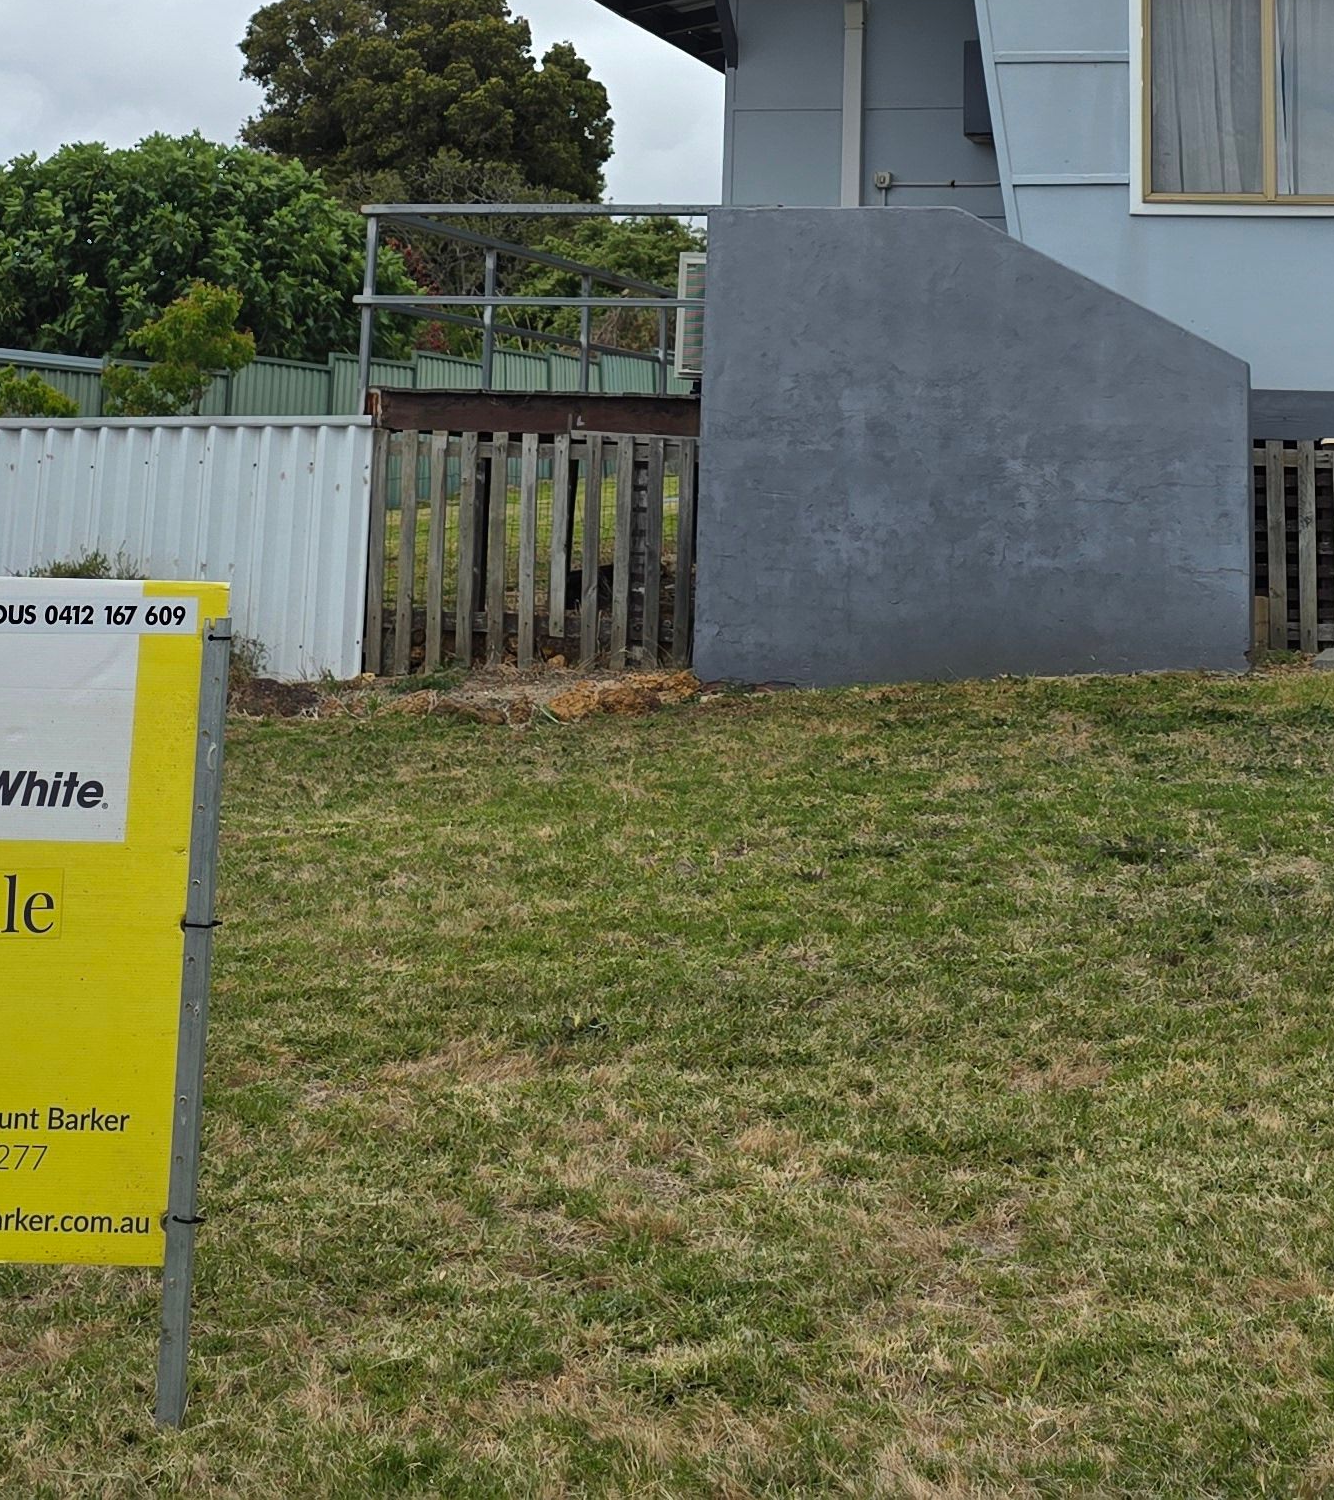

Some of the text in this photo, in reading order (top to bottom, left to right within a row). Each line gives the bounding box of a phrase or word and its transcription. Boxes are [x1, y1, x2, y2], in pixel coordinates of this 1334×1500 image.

[44, 604, 95, 626] 0412
[103, 605, 138, 626] 167
[144, 605, 187, 626] 609
[47, 1106, 131, 1132] Barker
